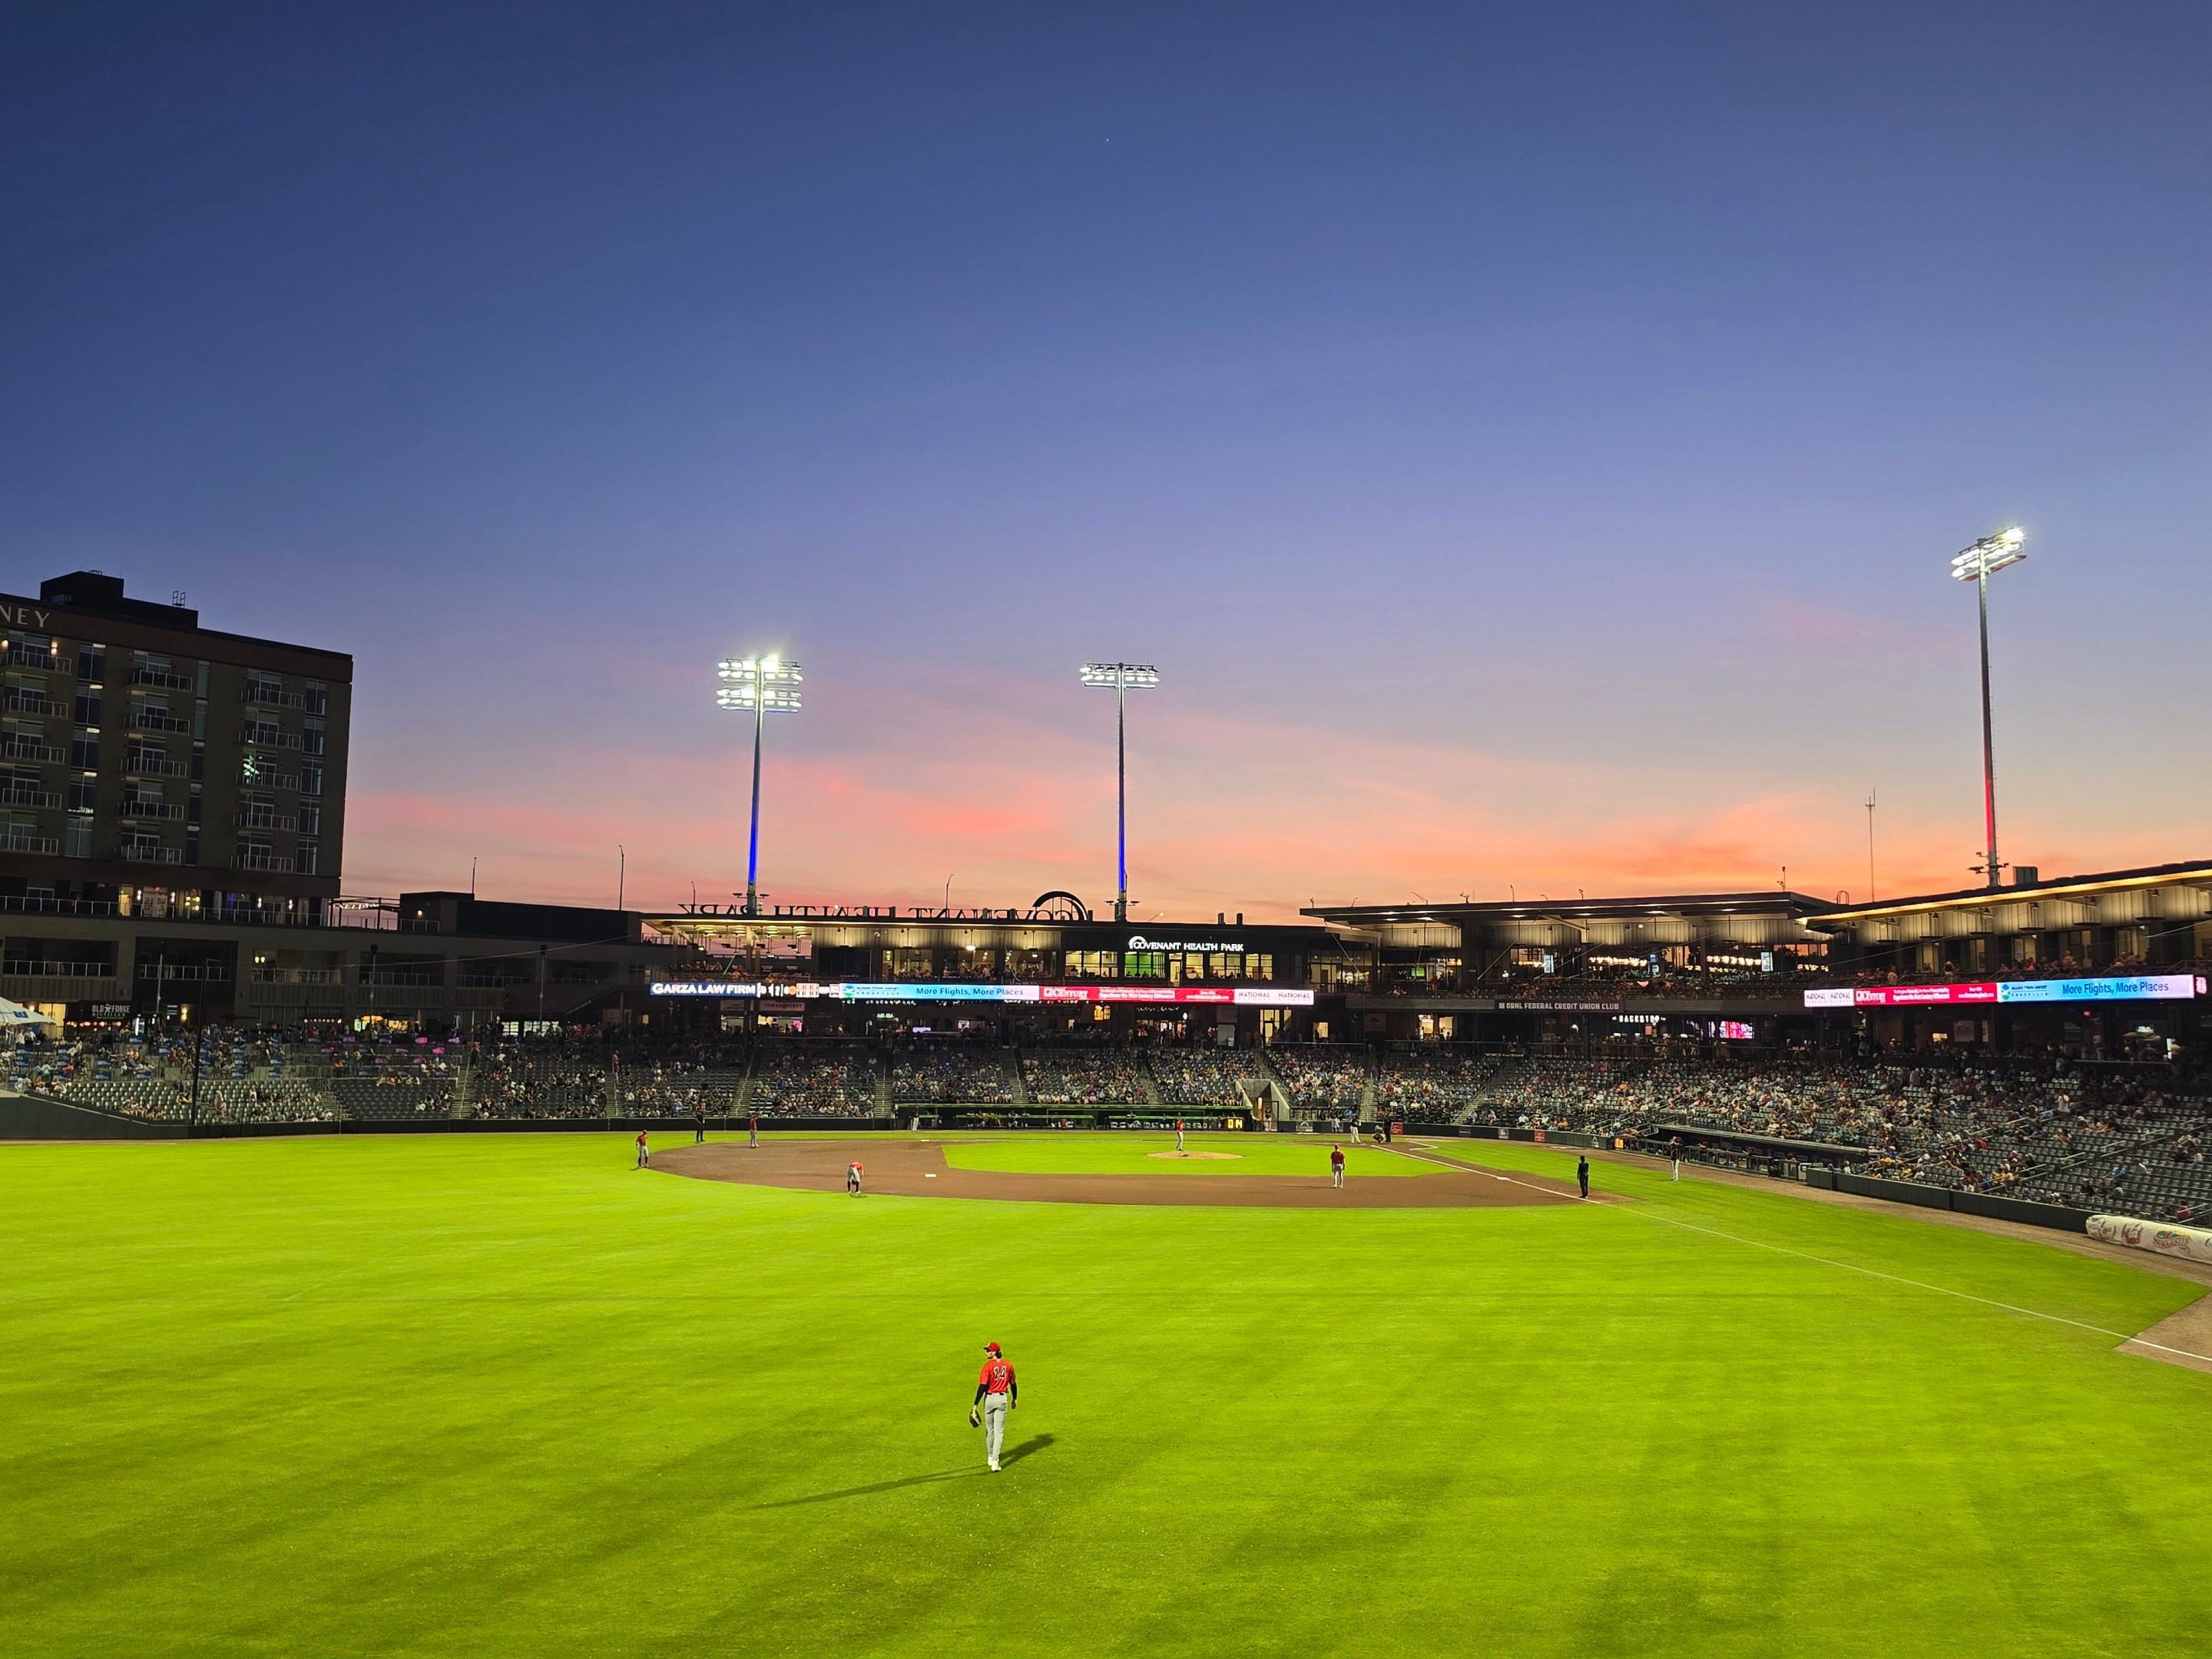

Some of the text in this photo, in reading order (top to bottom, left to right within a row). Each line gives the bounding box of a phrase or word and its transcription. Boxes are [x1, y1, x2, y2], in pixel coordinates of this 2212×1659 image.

[1130, 939, 1181, 950] COVENANT
[1184, 942, 1218, 951] HEALTH
[651, 983, 697, 994] GARZA
[698, 984, 726, 994] LAW
[727, 985, 756, 995] FIRM
[939, 987, 971, 996] Flights,
[2061, 981, 2169, 995] More Flights, More Places
[92, 1005, 131, 1013] OLD FORGE
[993, 1365, 1007, 1381] 14
